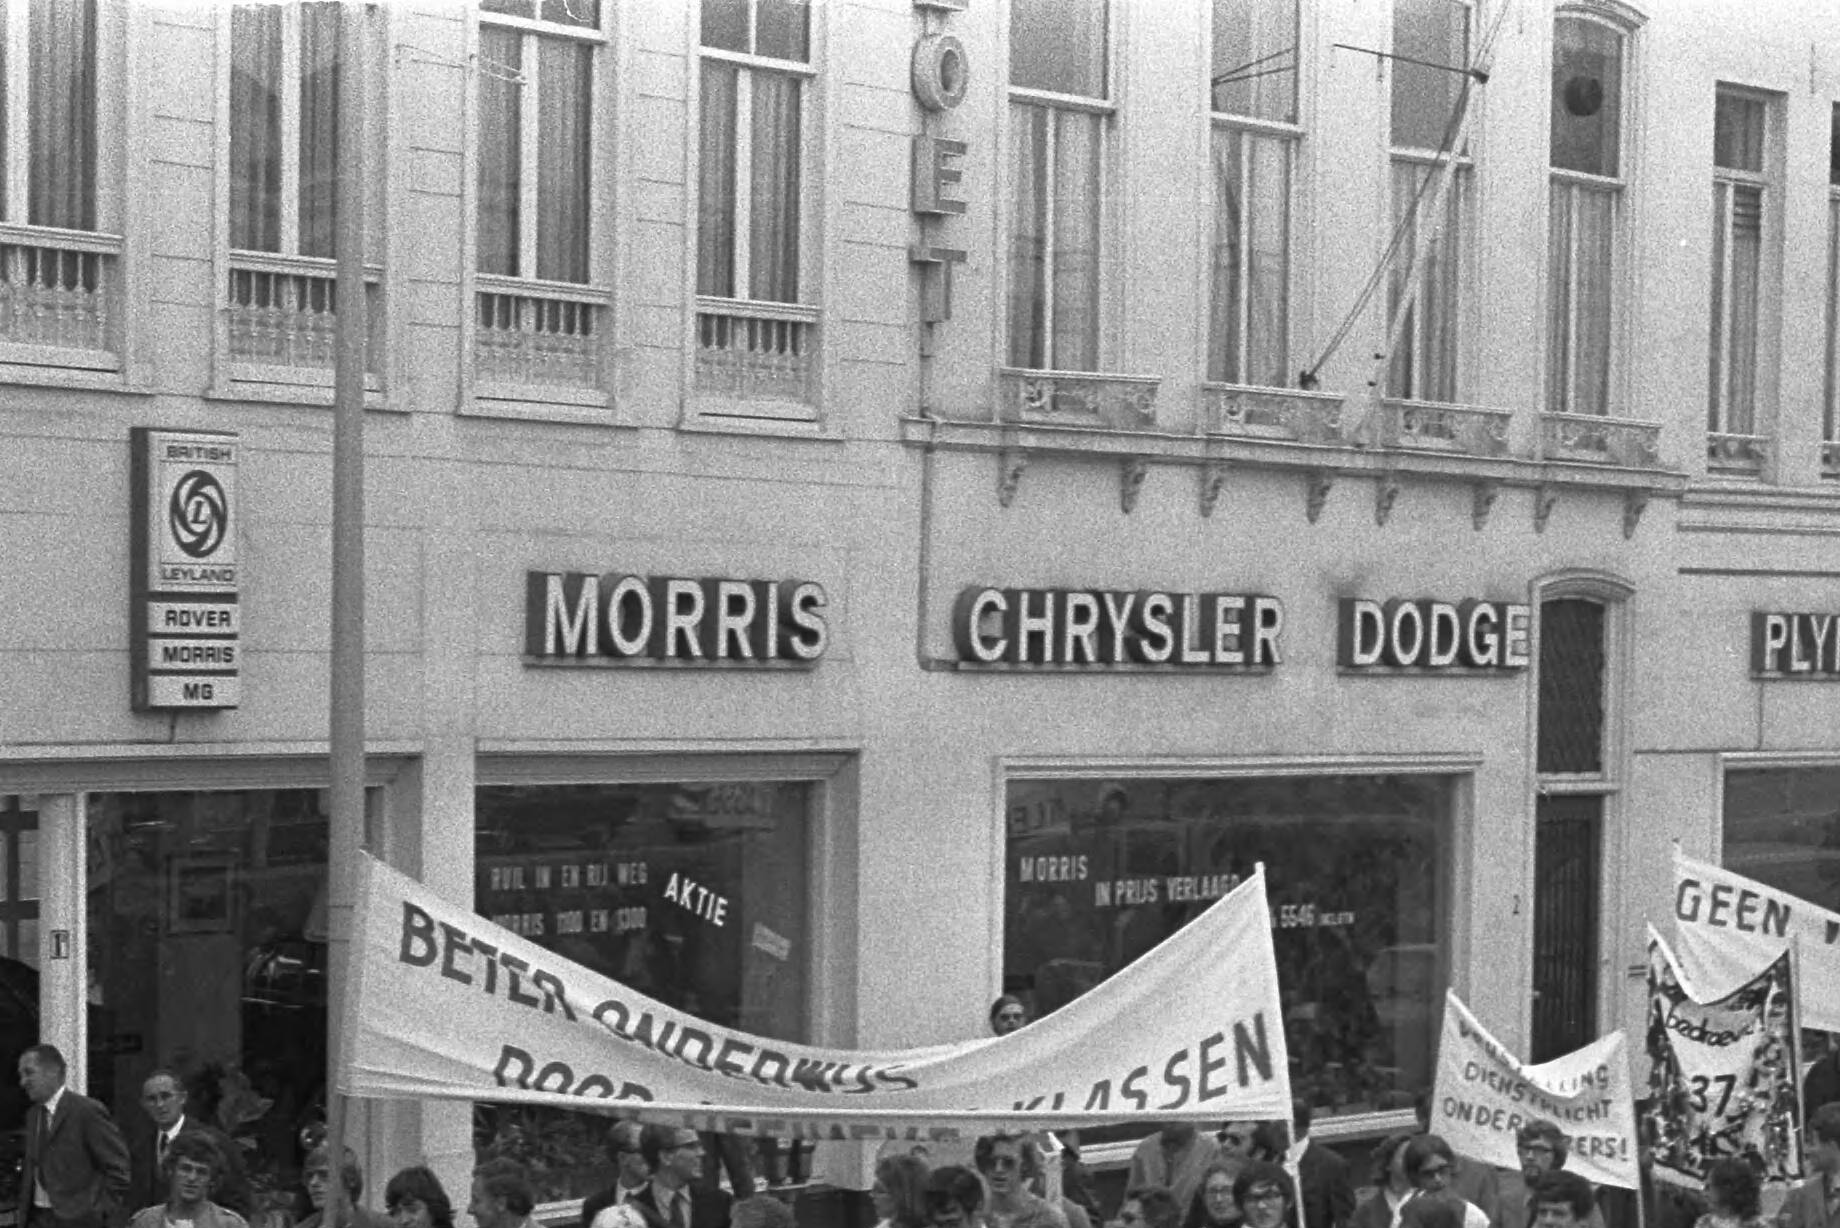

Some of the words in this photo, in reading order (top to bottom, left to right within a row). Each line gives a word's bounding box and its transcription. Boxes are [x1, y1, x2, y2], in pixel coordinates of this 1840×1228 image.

[167, 445, 232, 461] BRITISH
[161, 567, 234, 583] LEYLAND
[165, 609, 232, 628] ROVER
[540, 573, 829, 659] MORRIS
[968, 588, 1284, 665] CHRYSLER
[1353, 600, 1530, 666] DODGE
[162, 646, 235, 664] MORRIS
[183, 683, 214, 701] MG
[1020, 855, 1088, 883] MORRIS
[663, 872, 729, 927] AKTIE
[1115, 877, 1158, 905] PRIJS
[1675, 878, 1791, 937] GEEN
[400, 900, 579, 1023] BETER
[1690, 1073, 1737, 1119] 37
